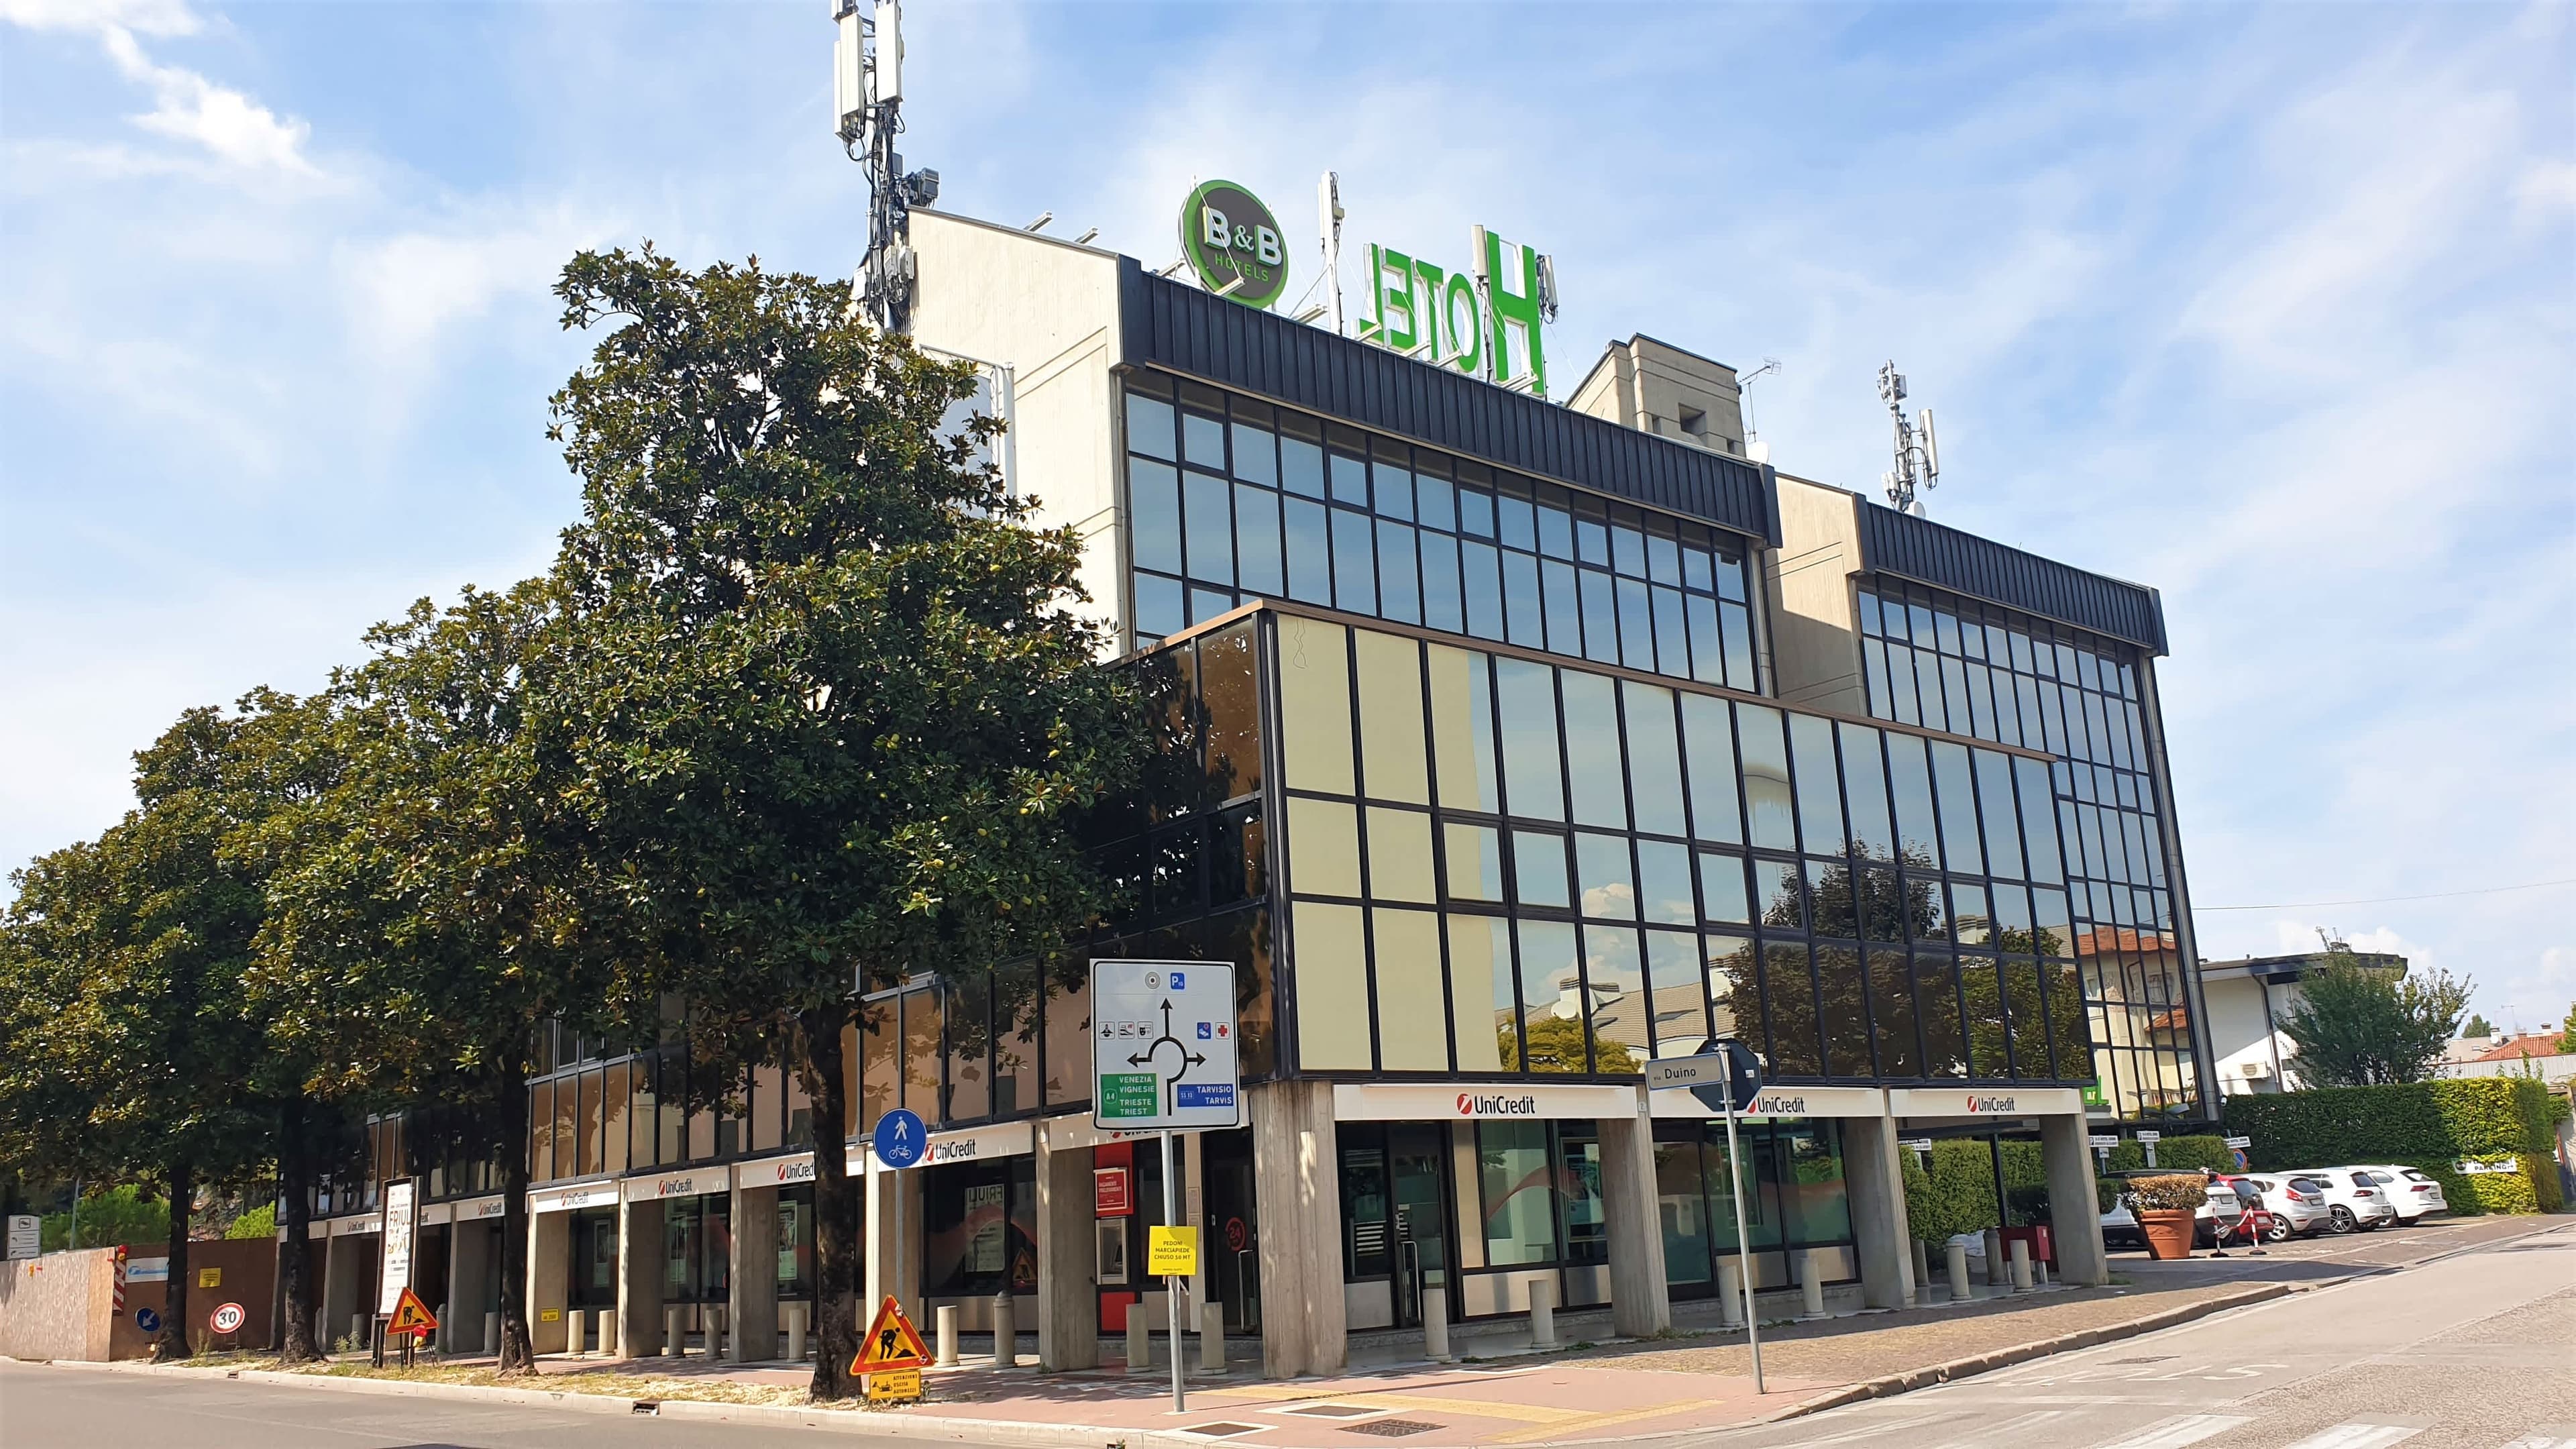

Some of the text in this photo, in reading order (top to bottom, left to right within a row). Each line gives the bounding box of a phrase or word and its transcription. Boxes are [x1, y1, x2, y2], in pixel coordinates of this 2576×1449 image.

[1202, 206, 1283, 266] B&B
[1215, 254, 1269, 282] HOTELS
[1664, 1068, 1697, 1079] Duino
[1106, 1092, 1115, 1100] A4
[1197, 1085, 1232, 1093] TARVISIO
[1474, 1095, 1536, 1114] UniCredit
[1758, 1097, 1805, 1113] UniCredit
[1978, 1097, 2015, 1112] UniCredit
[936, 1139, 976, 1160] UniCredit
[786, 1163, 814, 1179] UniCred
[665, 1178, 692, 1194] UniCredit
[566, 1191, 589, 1205] UniCredit
[483, 1202, 502, 1215] UniCredit
[389, 1209, 411, 1227] FRIUL
[219, 1311, 237, 1326] 30
